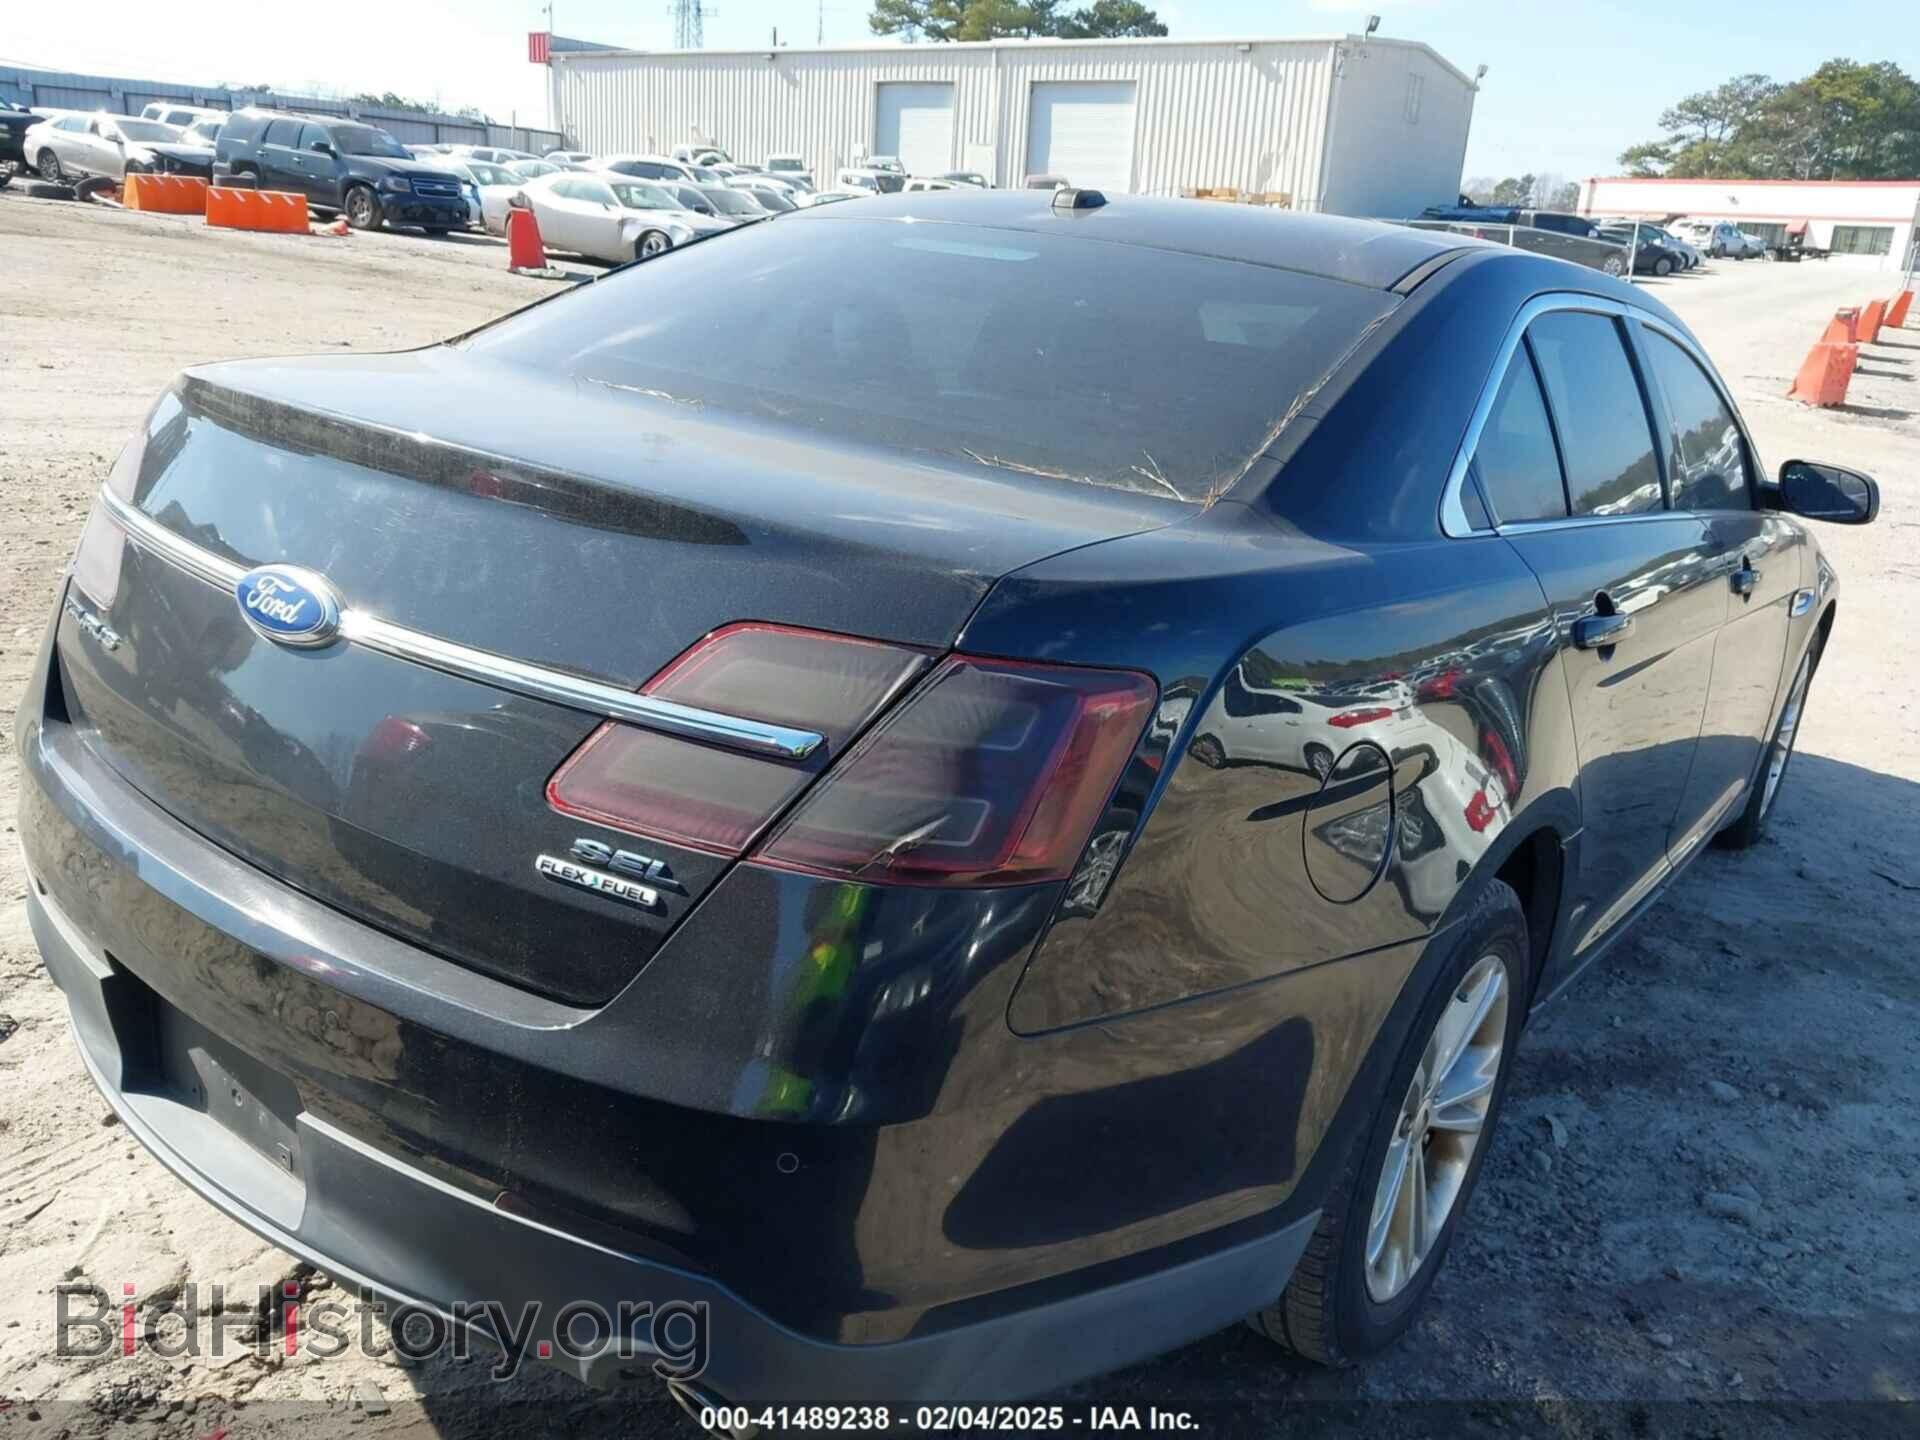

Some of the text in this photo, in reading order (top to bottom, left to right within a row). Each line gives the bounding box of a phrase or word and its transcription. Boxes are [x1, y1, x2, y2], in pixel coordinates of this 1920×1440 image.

[247, 576, 306, 624] Ford
[540, 859, 650, 903] FLEX FUEL
[569, 838, 680, 886] SEL
